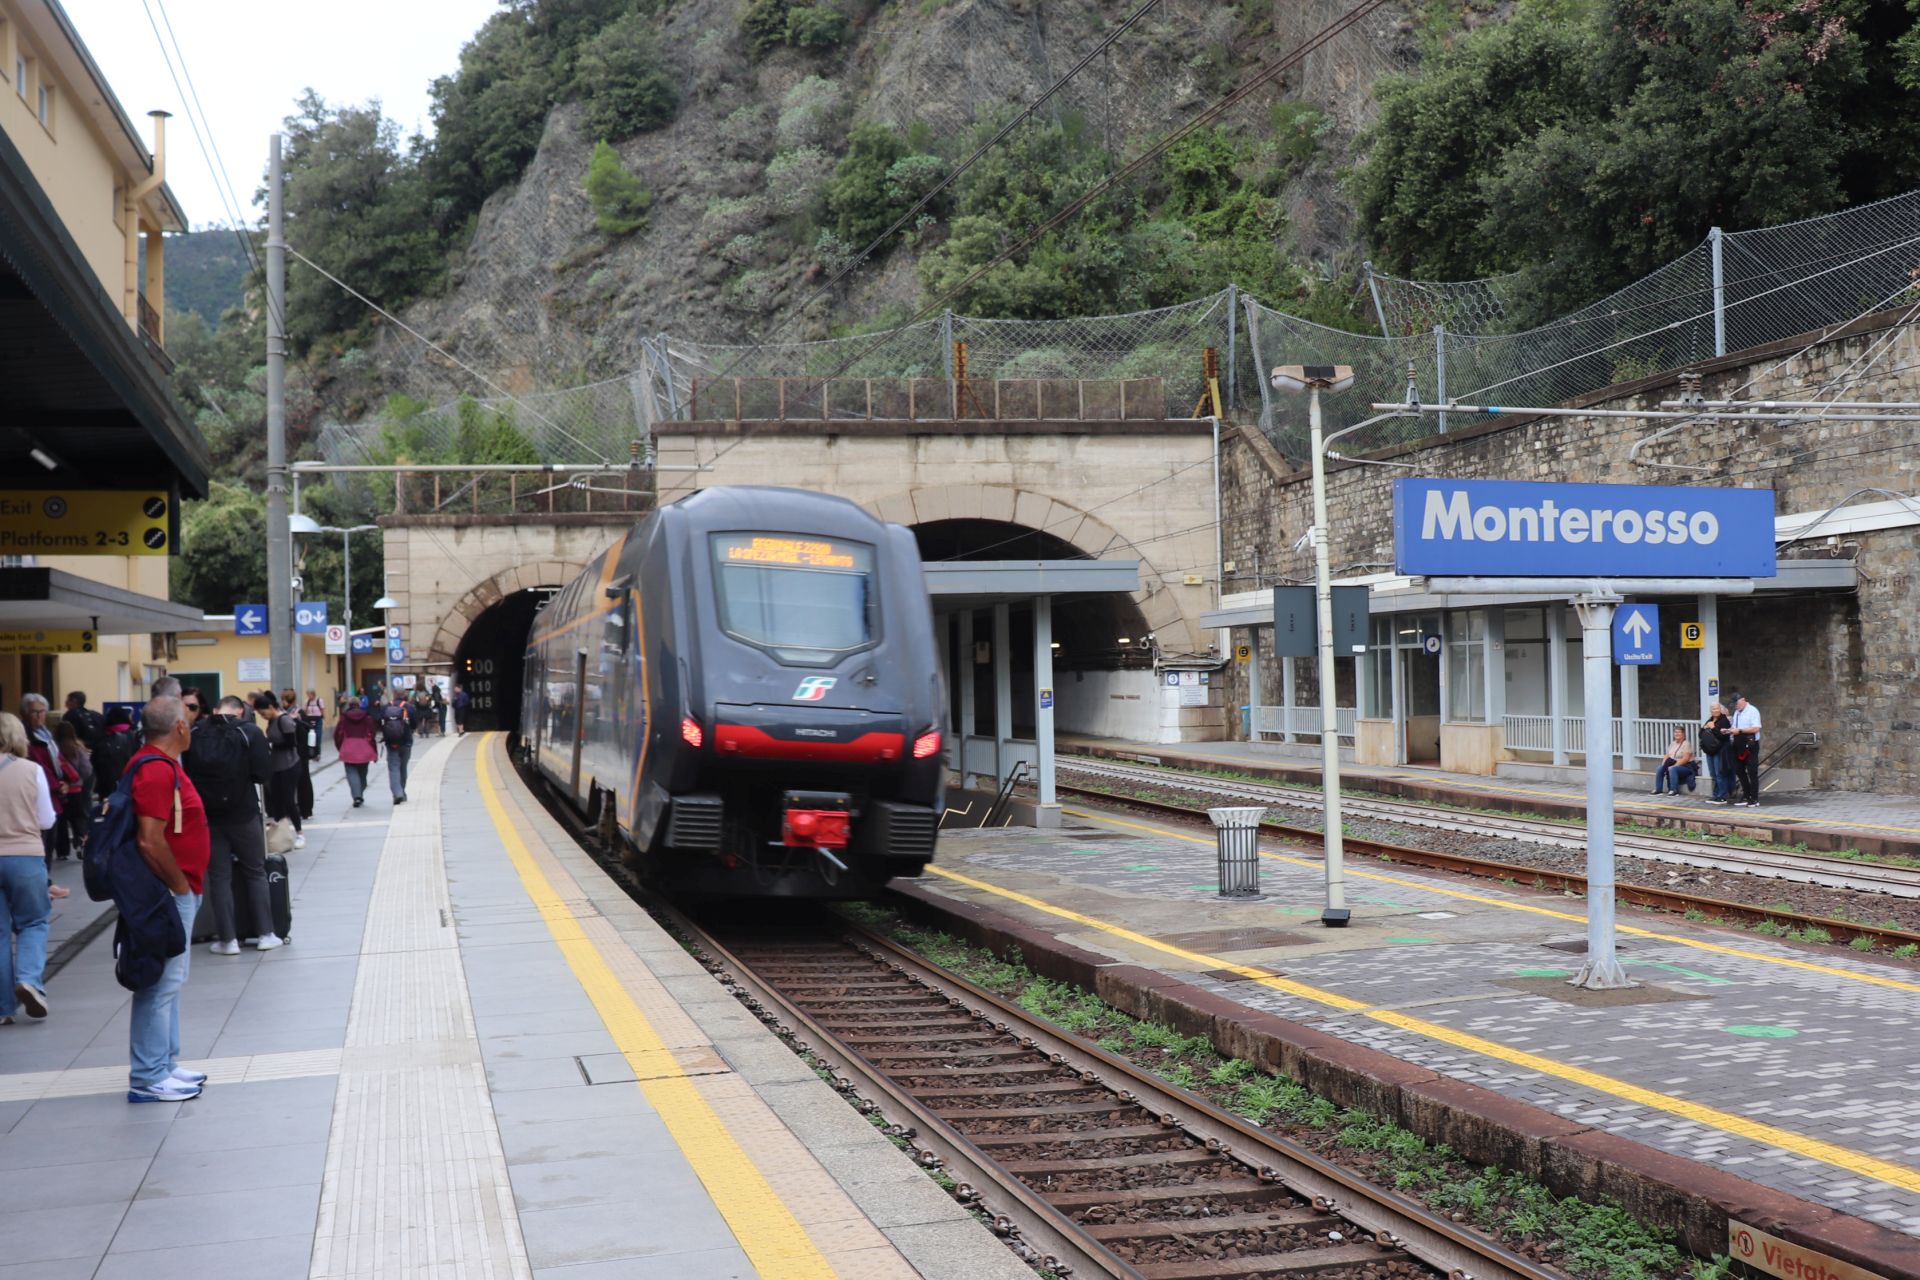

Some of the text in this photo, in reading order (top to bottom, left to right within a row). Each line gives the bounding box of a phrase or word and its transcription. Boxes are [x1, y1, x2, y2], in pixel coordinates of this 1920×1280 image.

[1, 500, 32, 514] Exit
[1421, 490, 1719, 545] Monterosso
[1, 530, 129, 546] Platforms 2-3
[470, 659, 493, 674] 00
[471, 680, 491, 692] 110
[471, 697, 492, 709] 115
[795, 728, 837, 738] HITACHI
